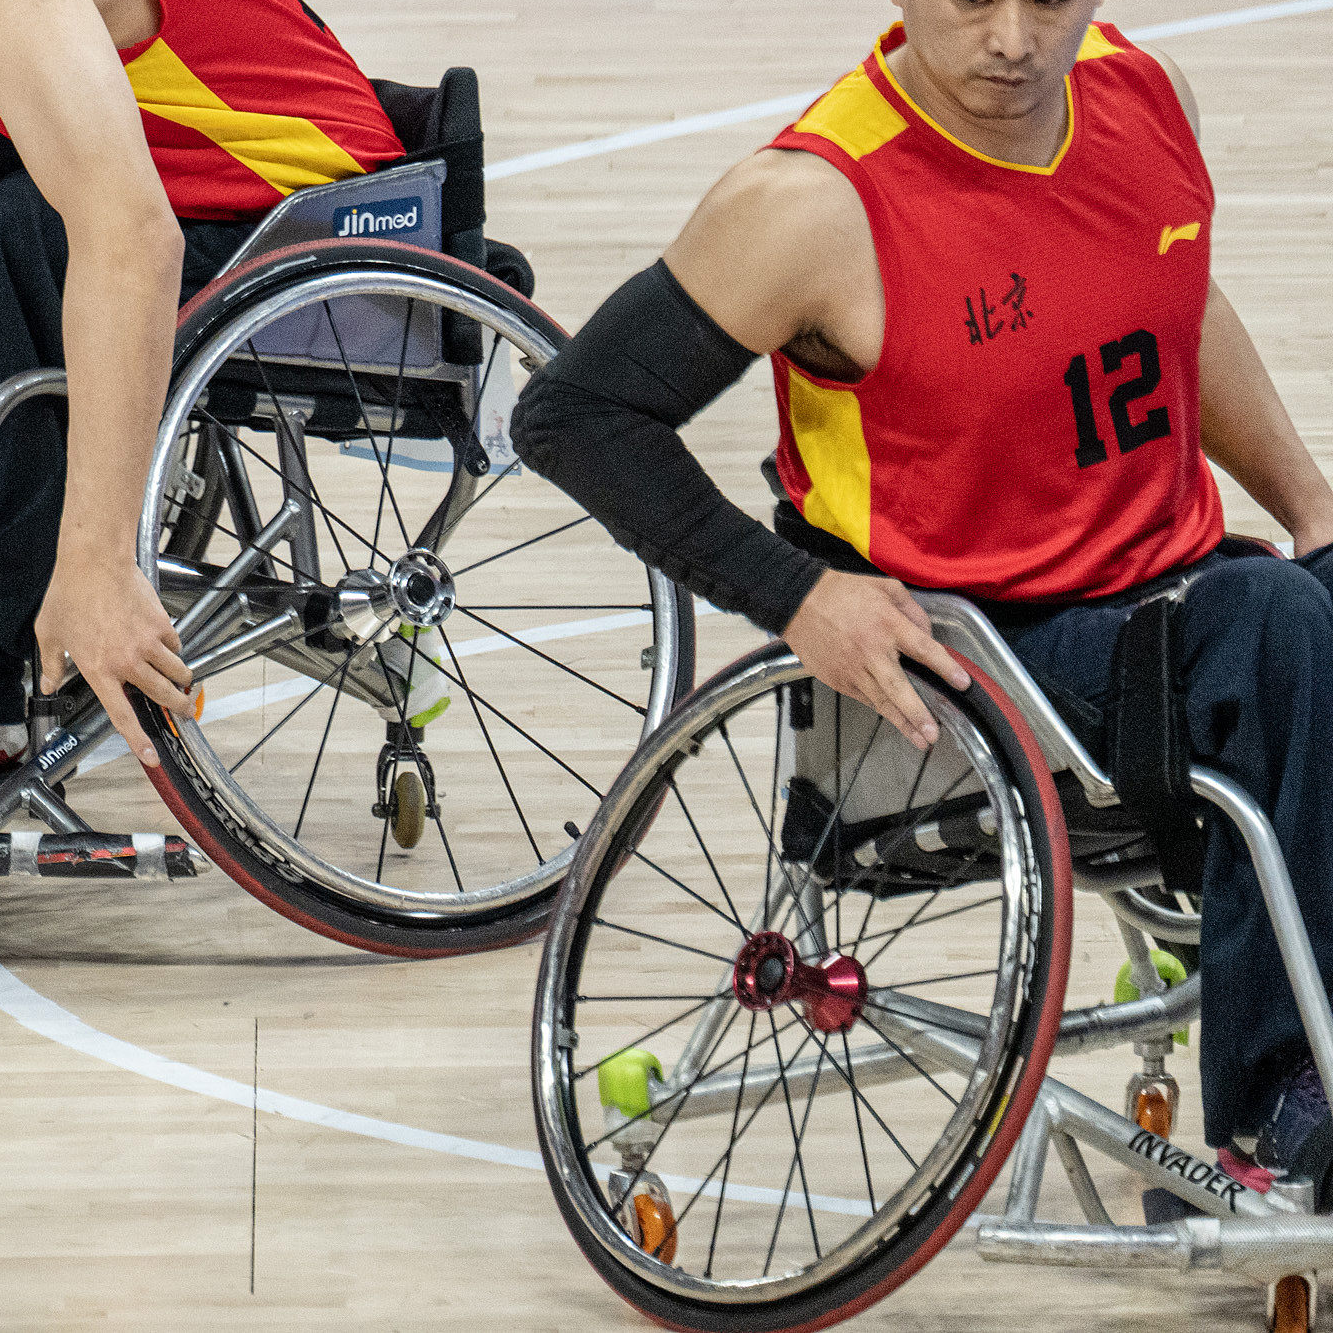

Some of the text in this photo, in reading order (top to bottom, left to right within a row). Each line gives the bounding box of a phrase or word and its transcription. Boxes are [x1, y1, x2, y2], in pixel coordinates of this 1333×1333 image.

[964, 272, 1034, 346] 北京
[1063, 328, 1172, 470] 12
[1128, 1130, 1247, 1214] INVADER
